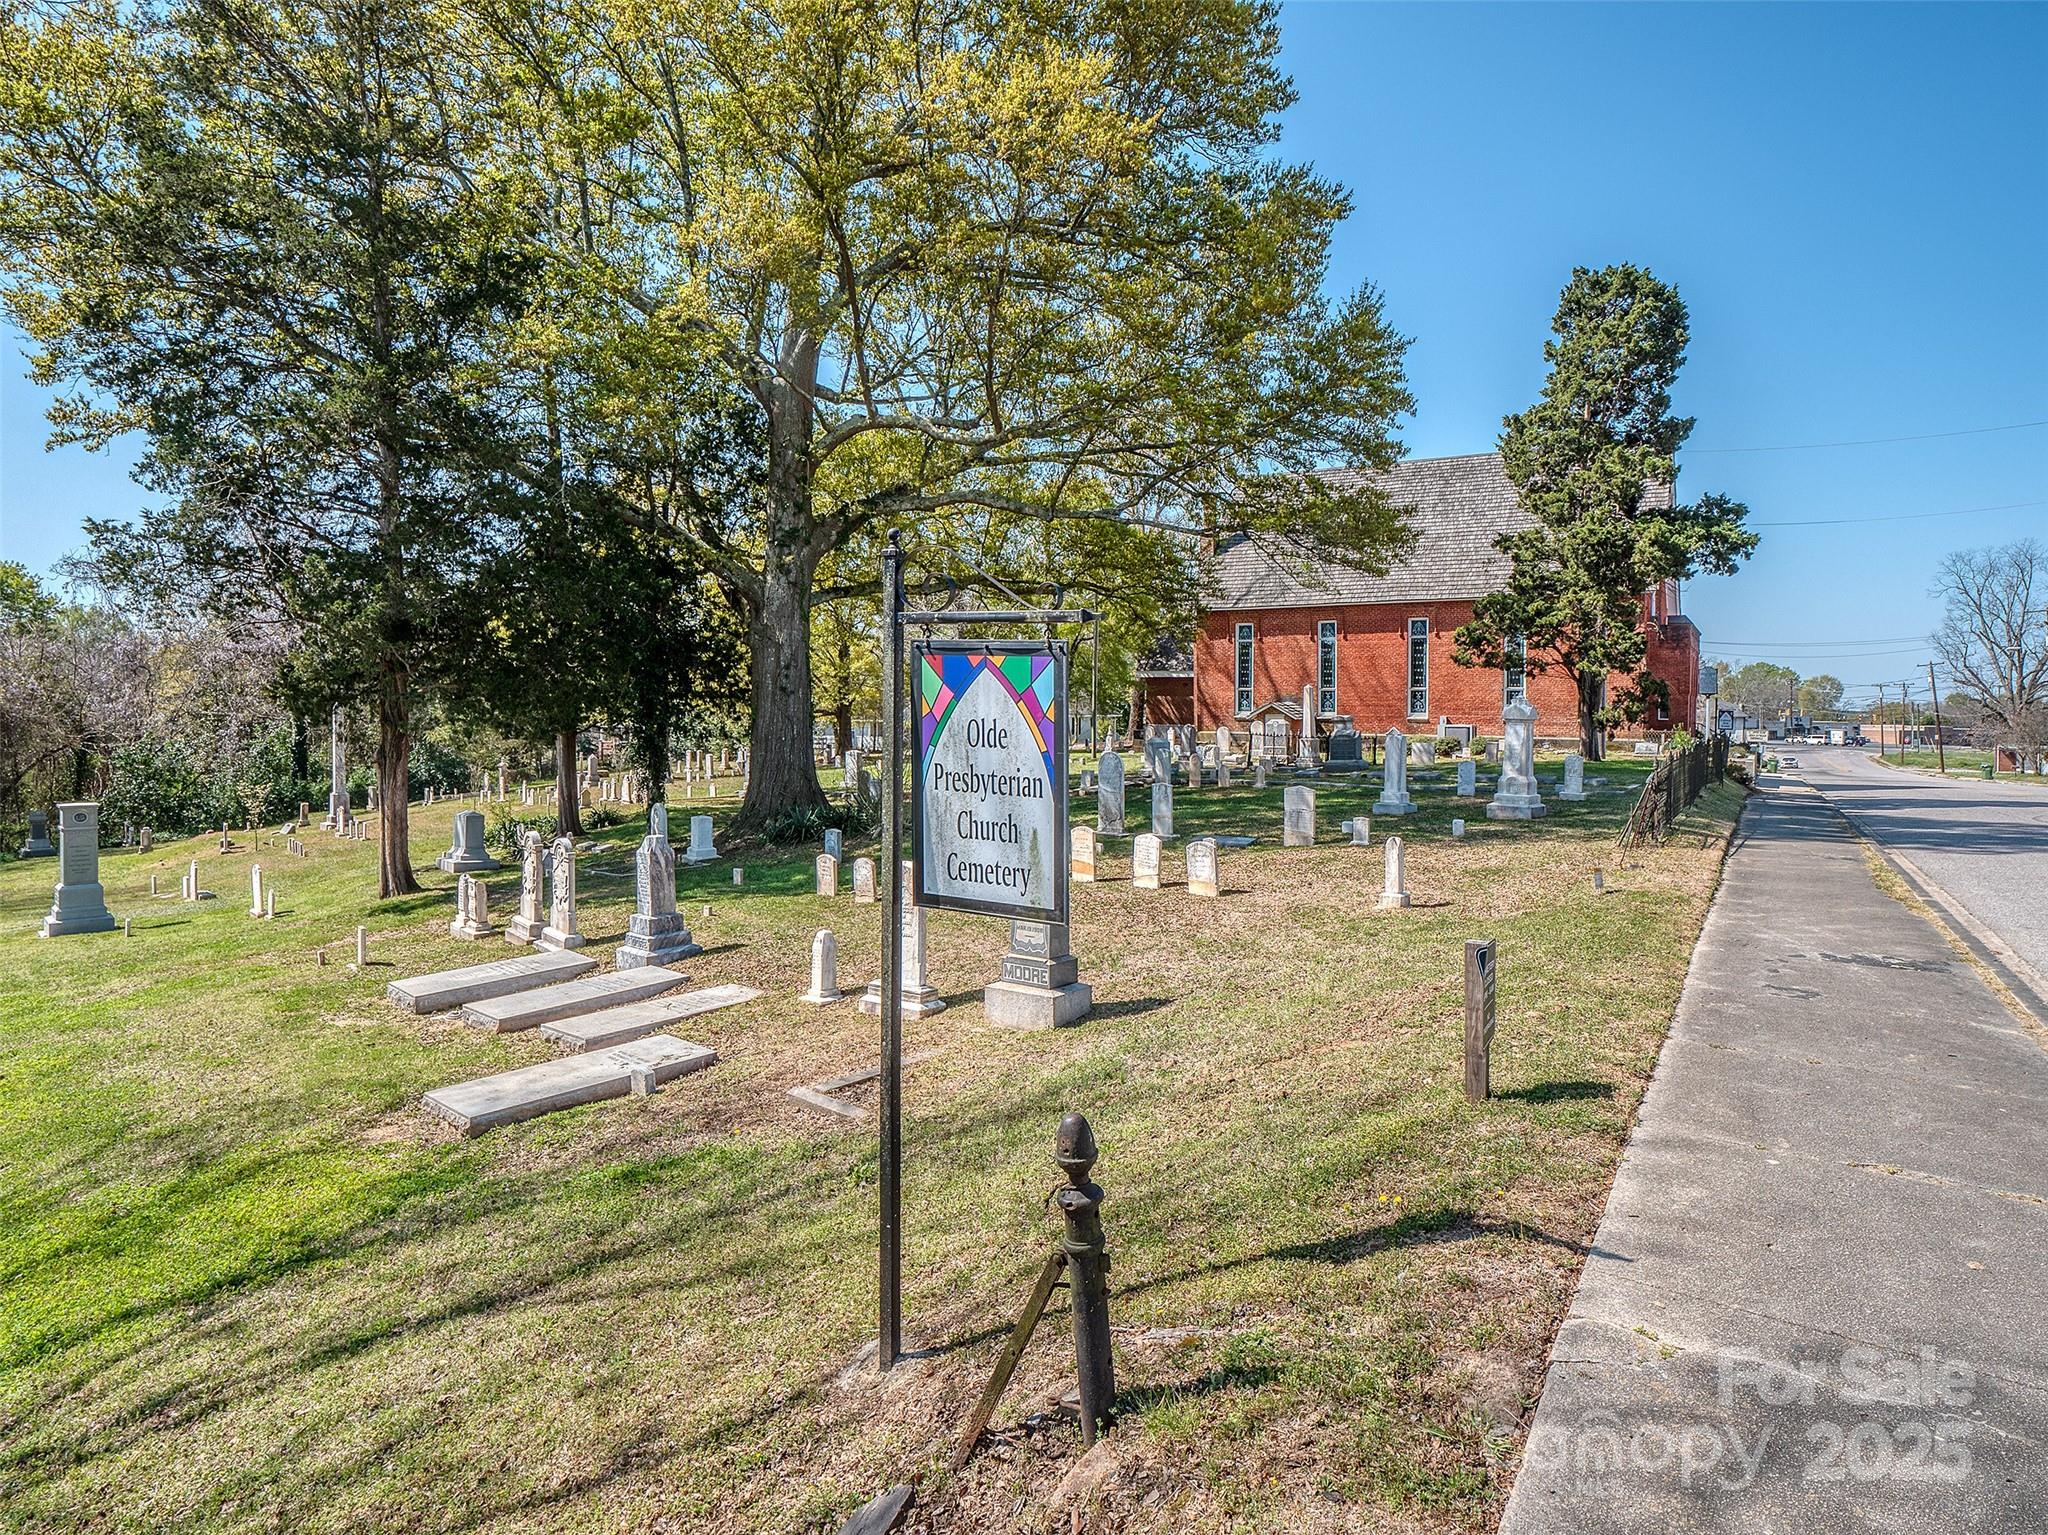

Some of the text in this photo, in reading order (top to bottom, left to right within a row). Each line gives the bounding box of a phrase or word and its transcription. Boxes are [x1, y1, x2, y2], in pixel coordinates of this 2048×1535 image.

[967, 718, 1008, 749] Olde
[934, 763, 1044, 802] Presbyterian
[957, 810, 1018, 844] Church
[947, 852, 1031, 897] Cemetery
[1004, 964, 1048, 985] MOORE
